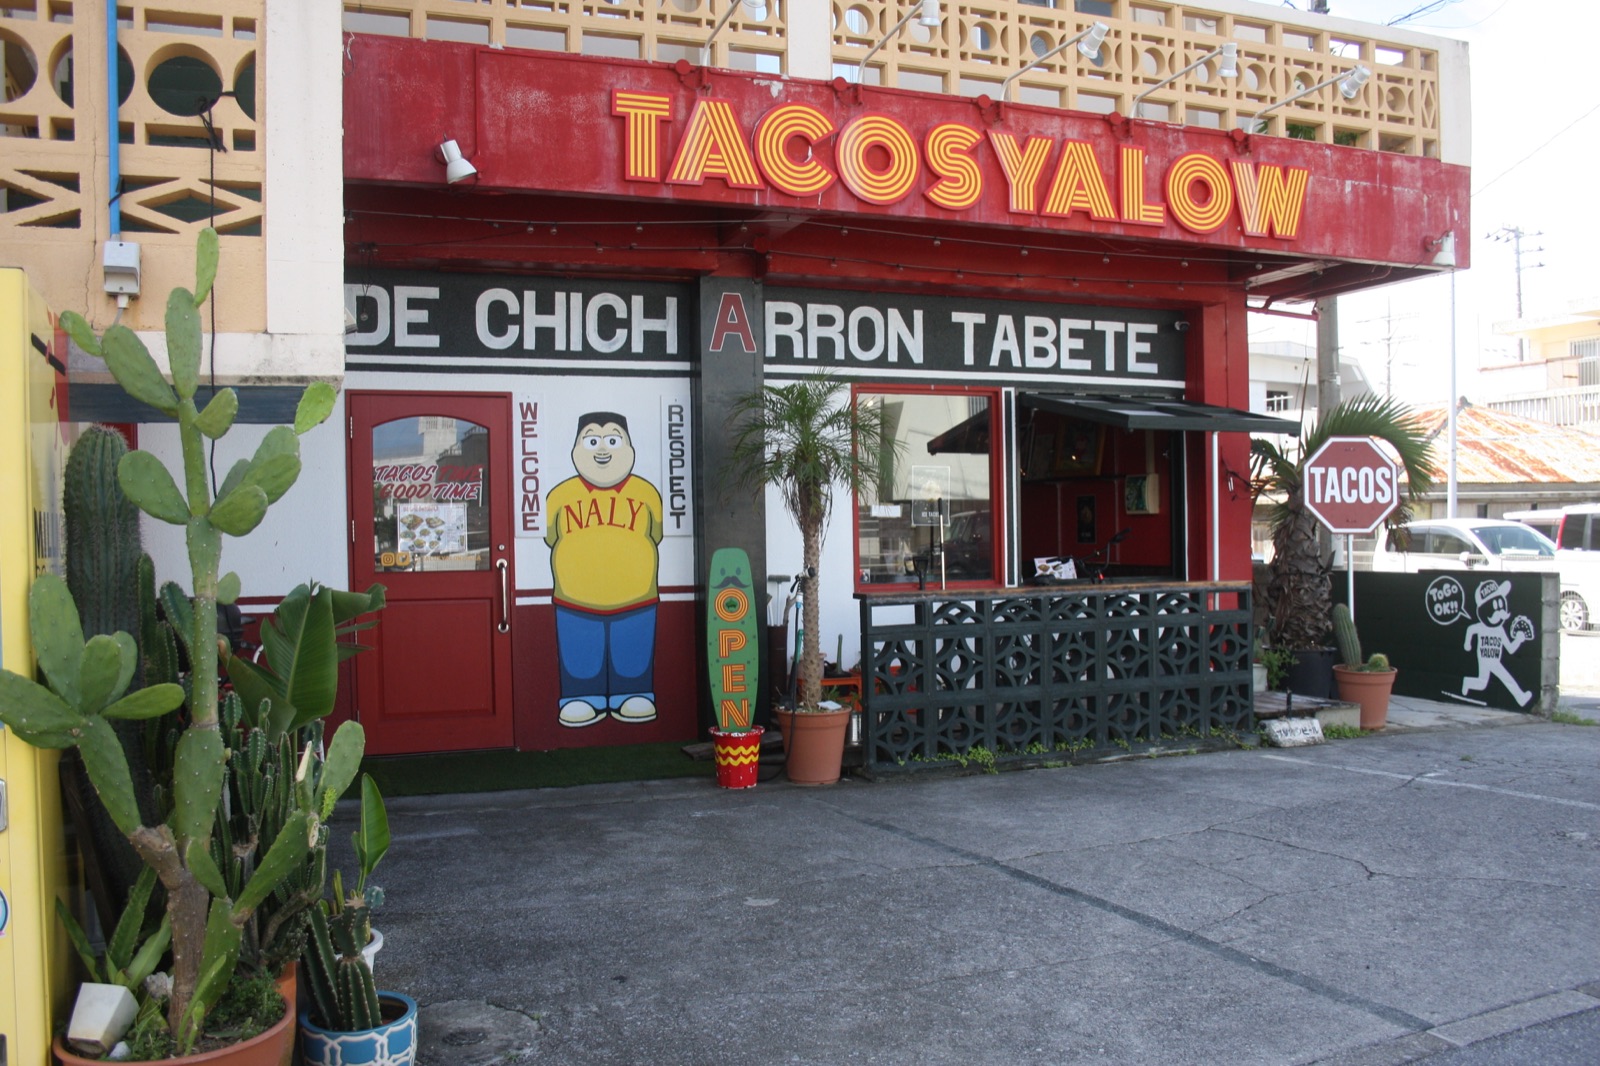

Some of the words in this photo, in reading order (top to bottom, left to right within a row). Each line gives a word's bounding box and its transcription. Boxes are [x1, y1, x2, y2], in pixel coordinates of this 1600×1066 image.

[343, 283, 440, 347] DE
[951, 311, 1159, 374] TABETE
[375, 464, 438, 482] TACOS
[519, 402, 540, 531] WELCOME
[668, 404, 686, 529] RESPECT
[379, 482, 432, 500] GOOD
[432, 481, 482, 500] TIME
[1309, 466, 1393, 503] TACOS
[564, 497, 644, 534] NALY
[1480, 582, 1499, 598] TACOS
[1434, 601, 1459, 616] OK!!
[1480, 636, 1502, 648] TACOS
[1480, 648, 1501, 659] YALOW
[714, 588, 750, 728] OPEN
